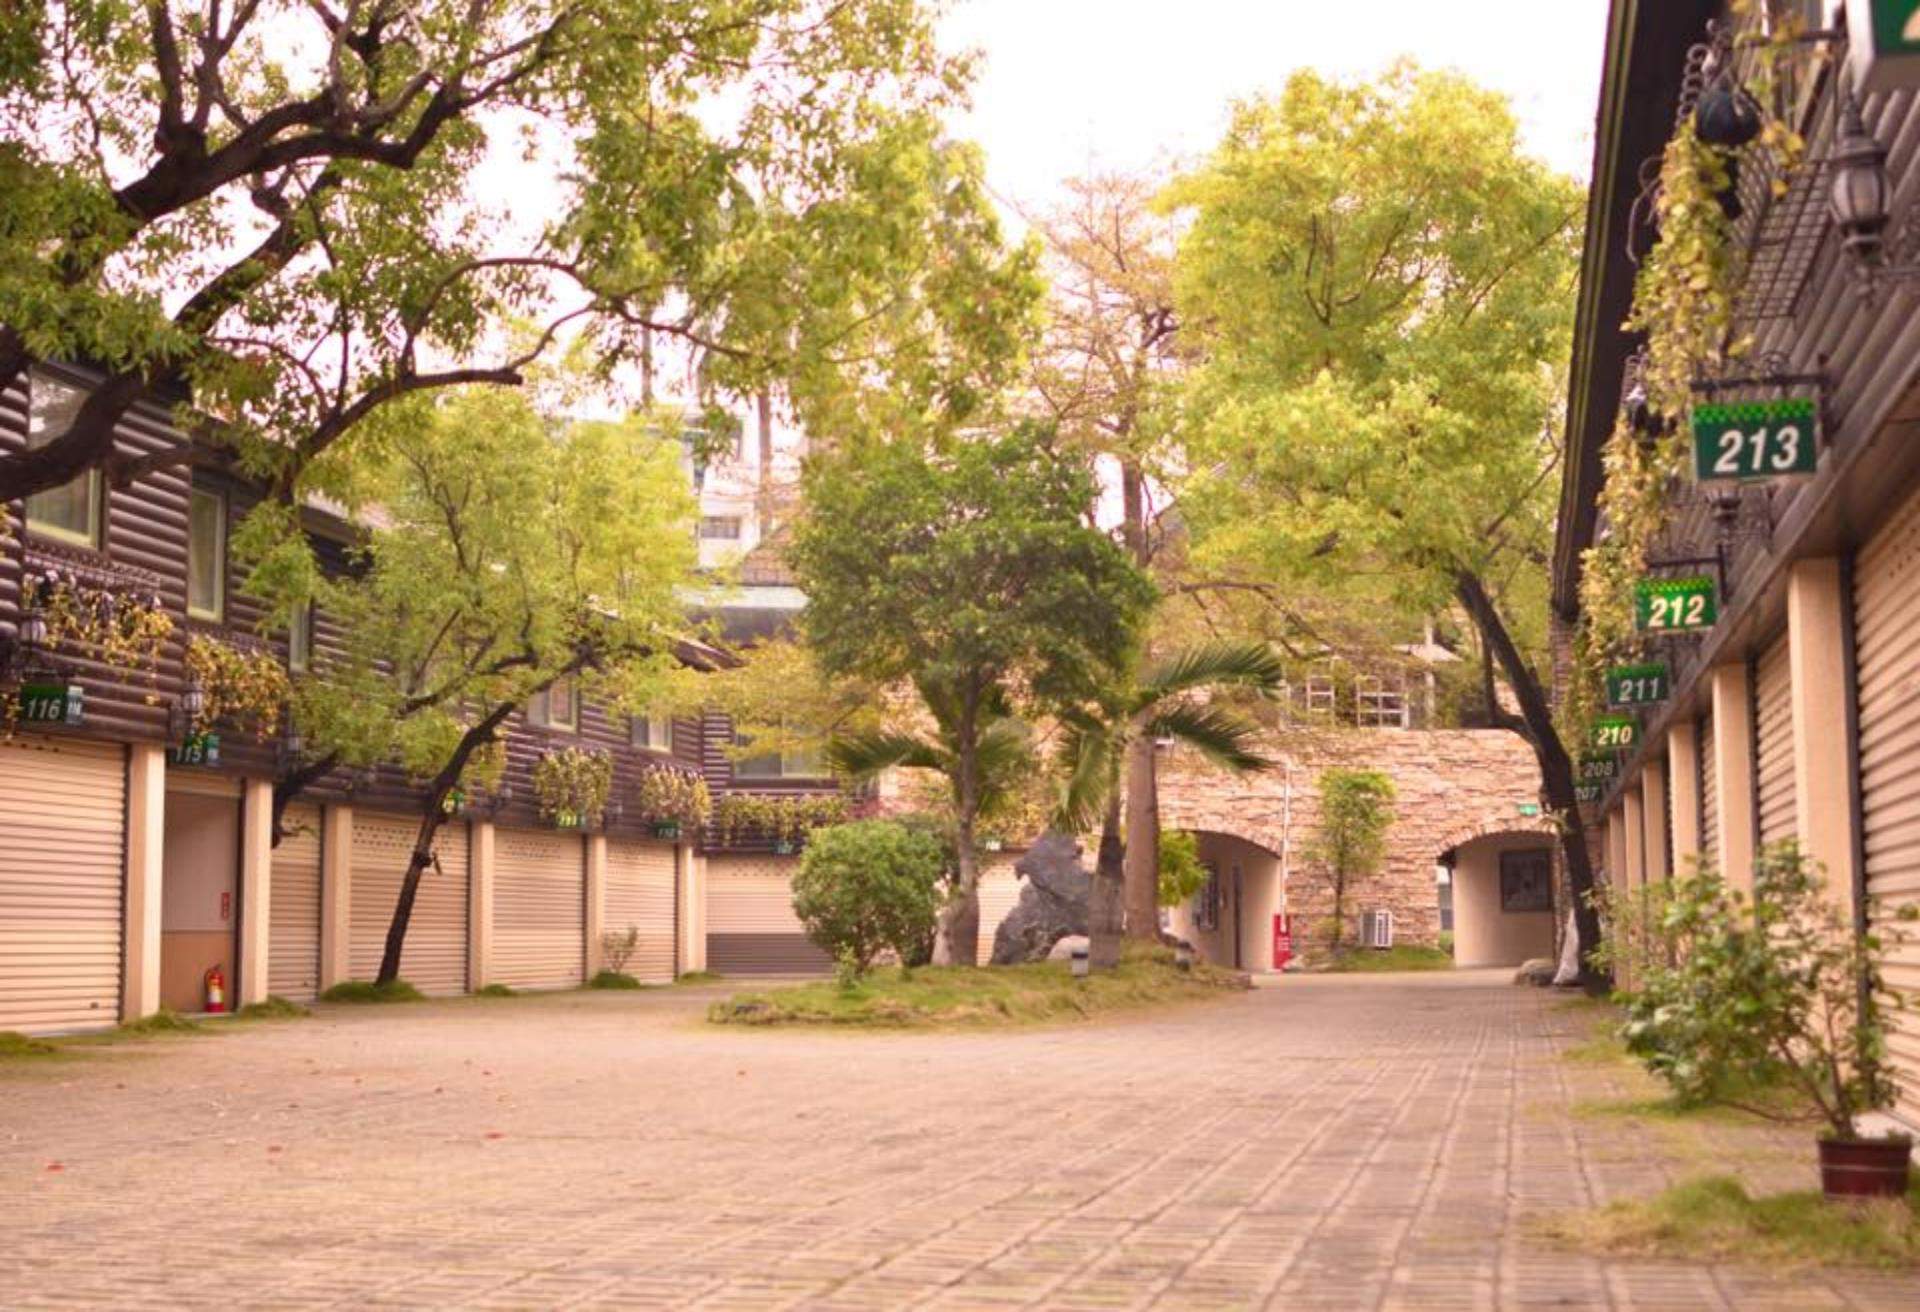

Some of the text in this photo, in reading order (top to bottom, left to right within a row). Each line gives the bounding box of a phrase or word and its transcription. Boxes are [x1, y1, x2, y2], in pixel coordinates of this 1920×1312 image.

[1713, 424, 1799, 473] 213
[1648, 594, 1705, 627] 212
[1619, 678, 1659, 701] 211
[28, 697, 61, 720] 116
[1597, 725, 1633, 745] 210
